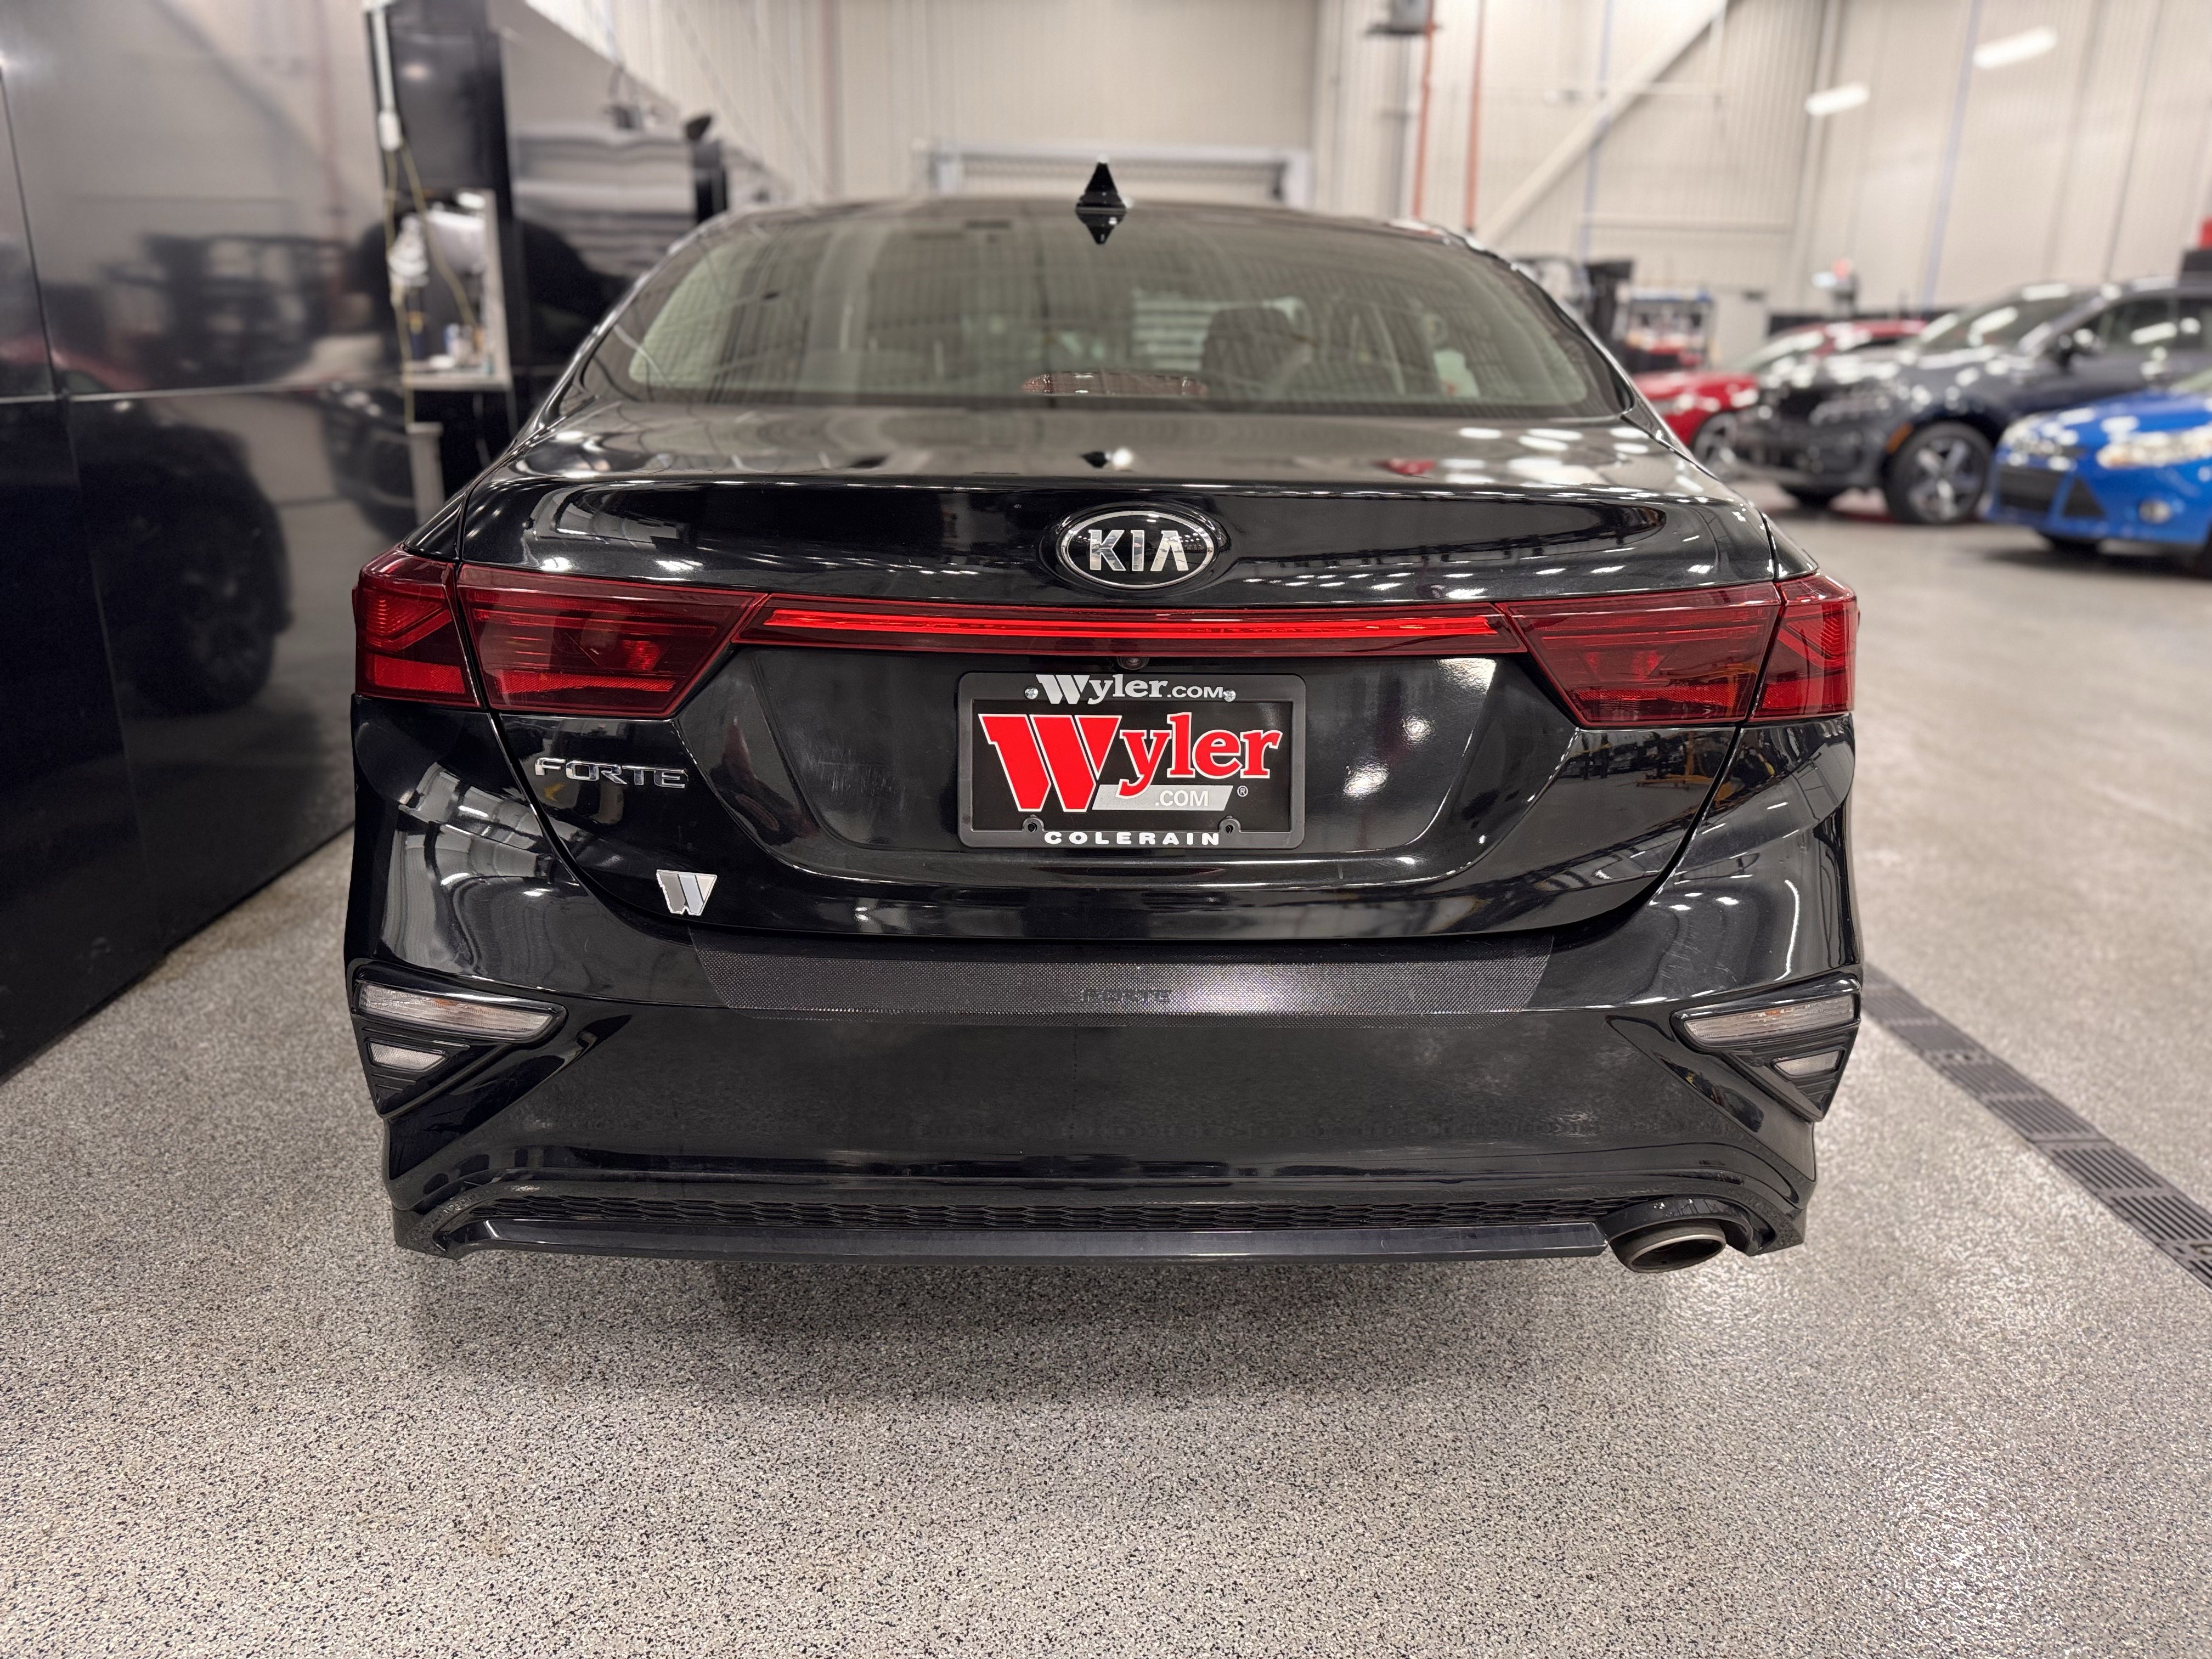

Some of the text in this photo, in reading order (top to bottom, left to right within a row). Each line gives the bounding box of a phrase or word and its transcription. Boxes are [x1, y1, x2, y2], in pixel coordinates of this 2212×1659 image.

[1088, 529, 1189, 572] KIA
[535, 757, 689, 789] FORTE
[978, 712, 1283, 812] Wyler
[1044, 831, 1220, 846] COLERAIN
